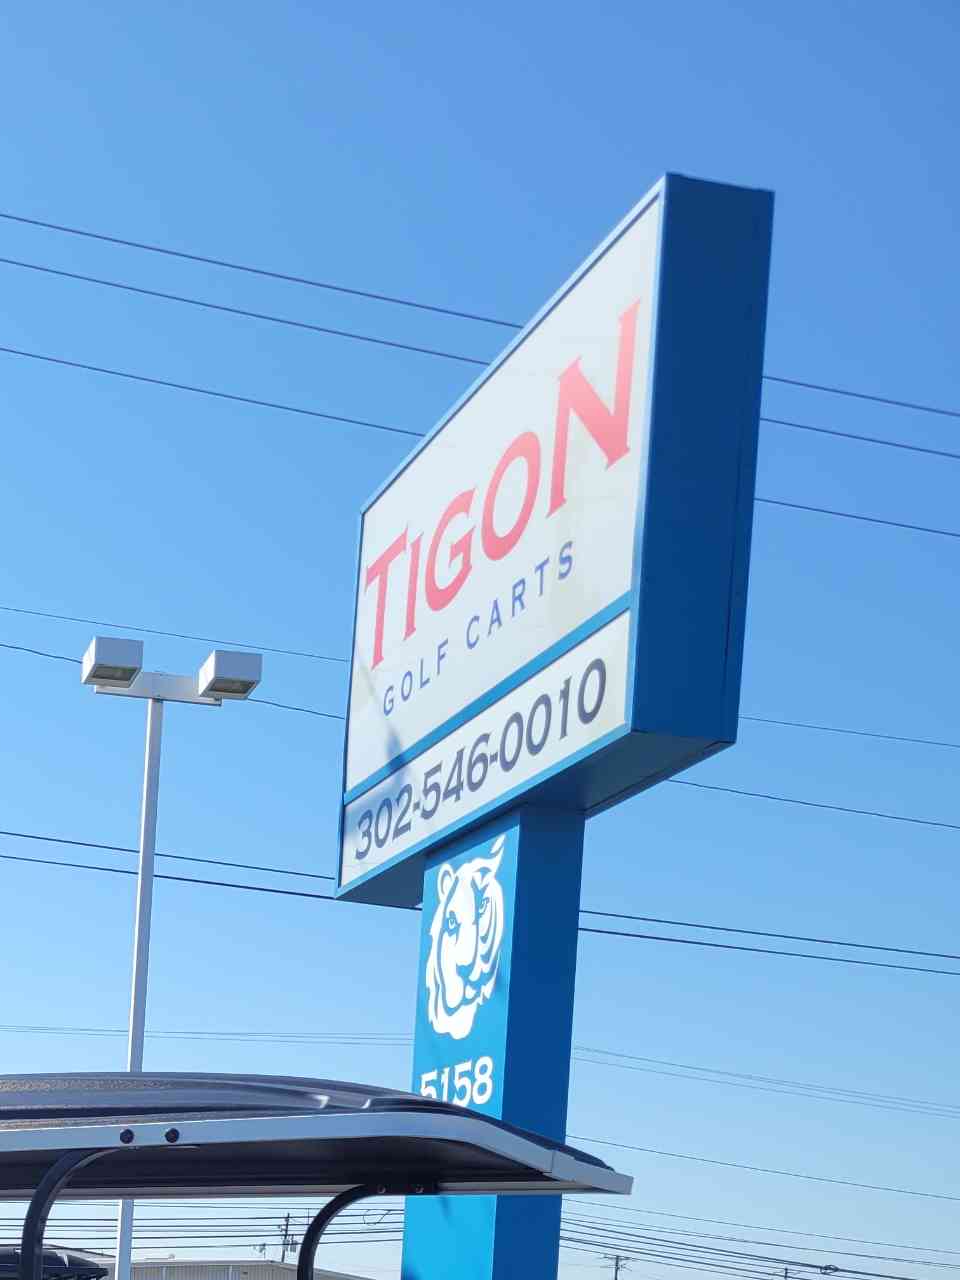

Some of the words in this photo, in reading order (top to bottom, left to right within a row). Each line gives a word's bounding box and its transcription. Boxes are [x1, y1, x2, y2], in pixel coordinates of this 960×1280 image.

[366, 299, 640, 668] TIGON
[383, 638, 449, 716] GOLF
[467, 541, 574, 650] CARTS
[355, 658, 607, 860] 302-546-0010
